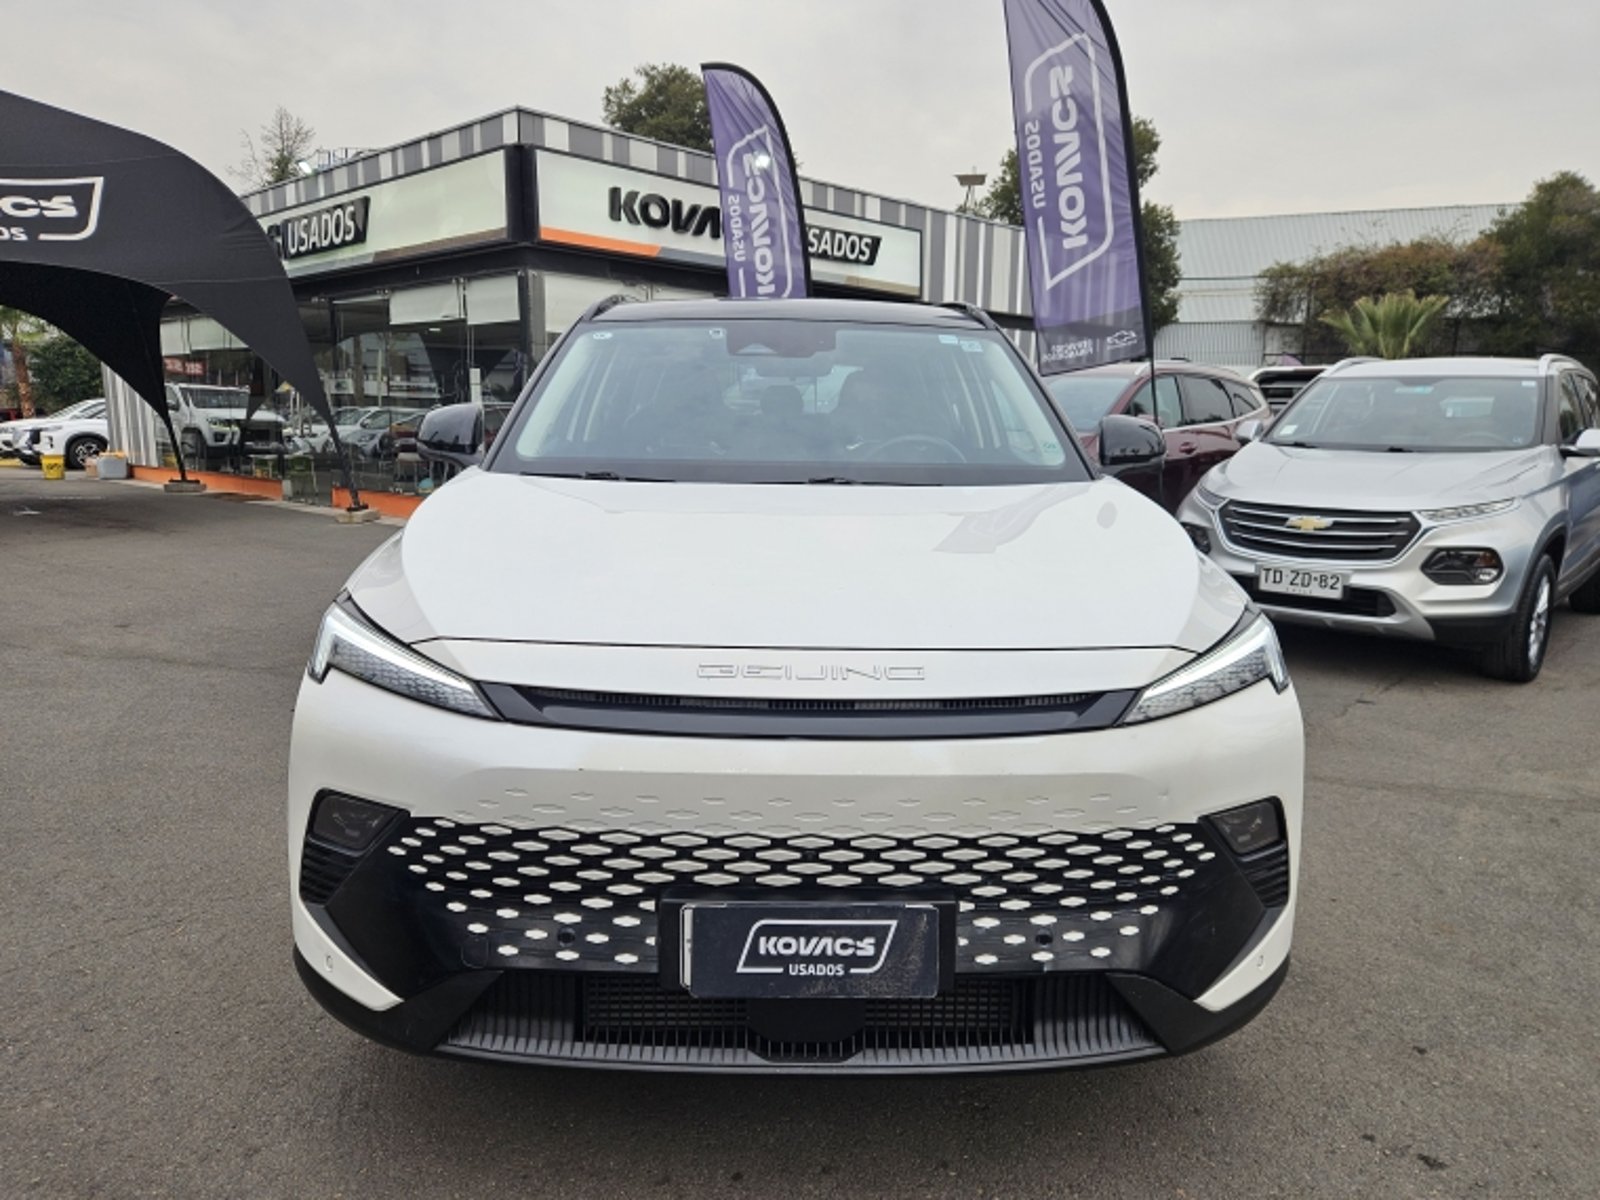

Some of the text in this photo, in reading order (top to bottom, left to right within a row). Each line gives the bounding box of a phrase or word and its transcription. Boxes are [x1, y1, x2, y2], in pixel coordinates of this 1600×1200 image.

[287, 205, 355, 254] USADOS
[608, 186, 872, 262] KOVA SADOS
[697, 664, 925, 682] BEIJING
[758, 936, 876, 957] KOVACS
[788, 963, 845, 977] USADOS
